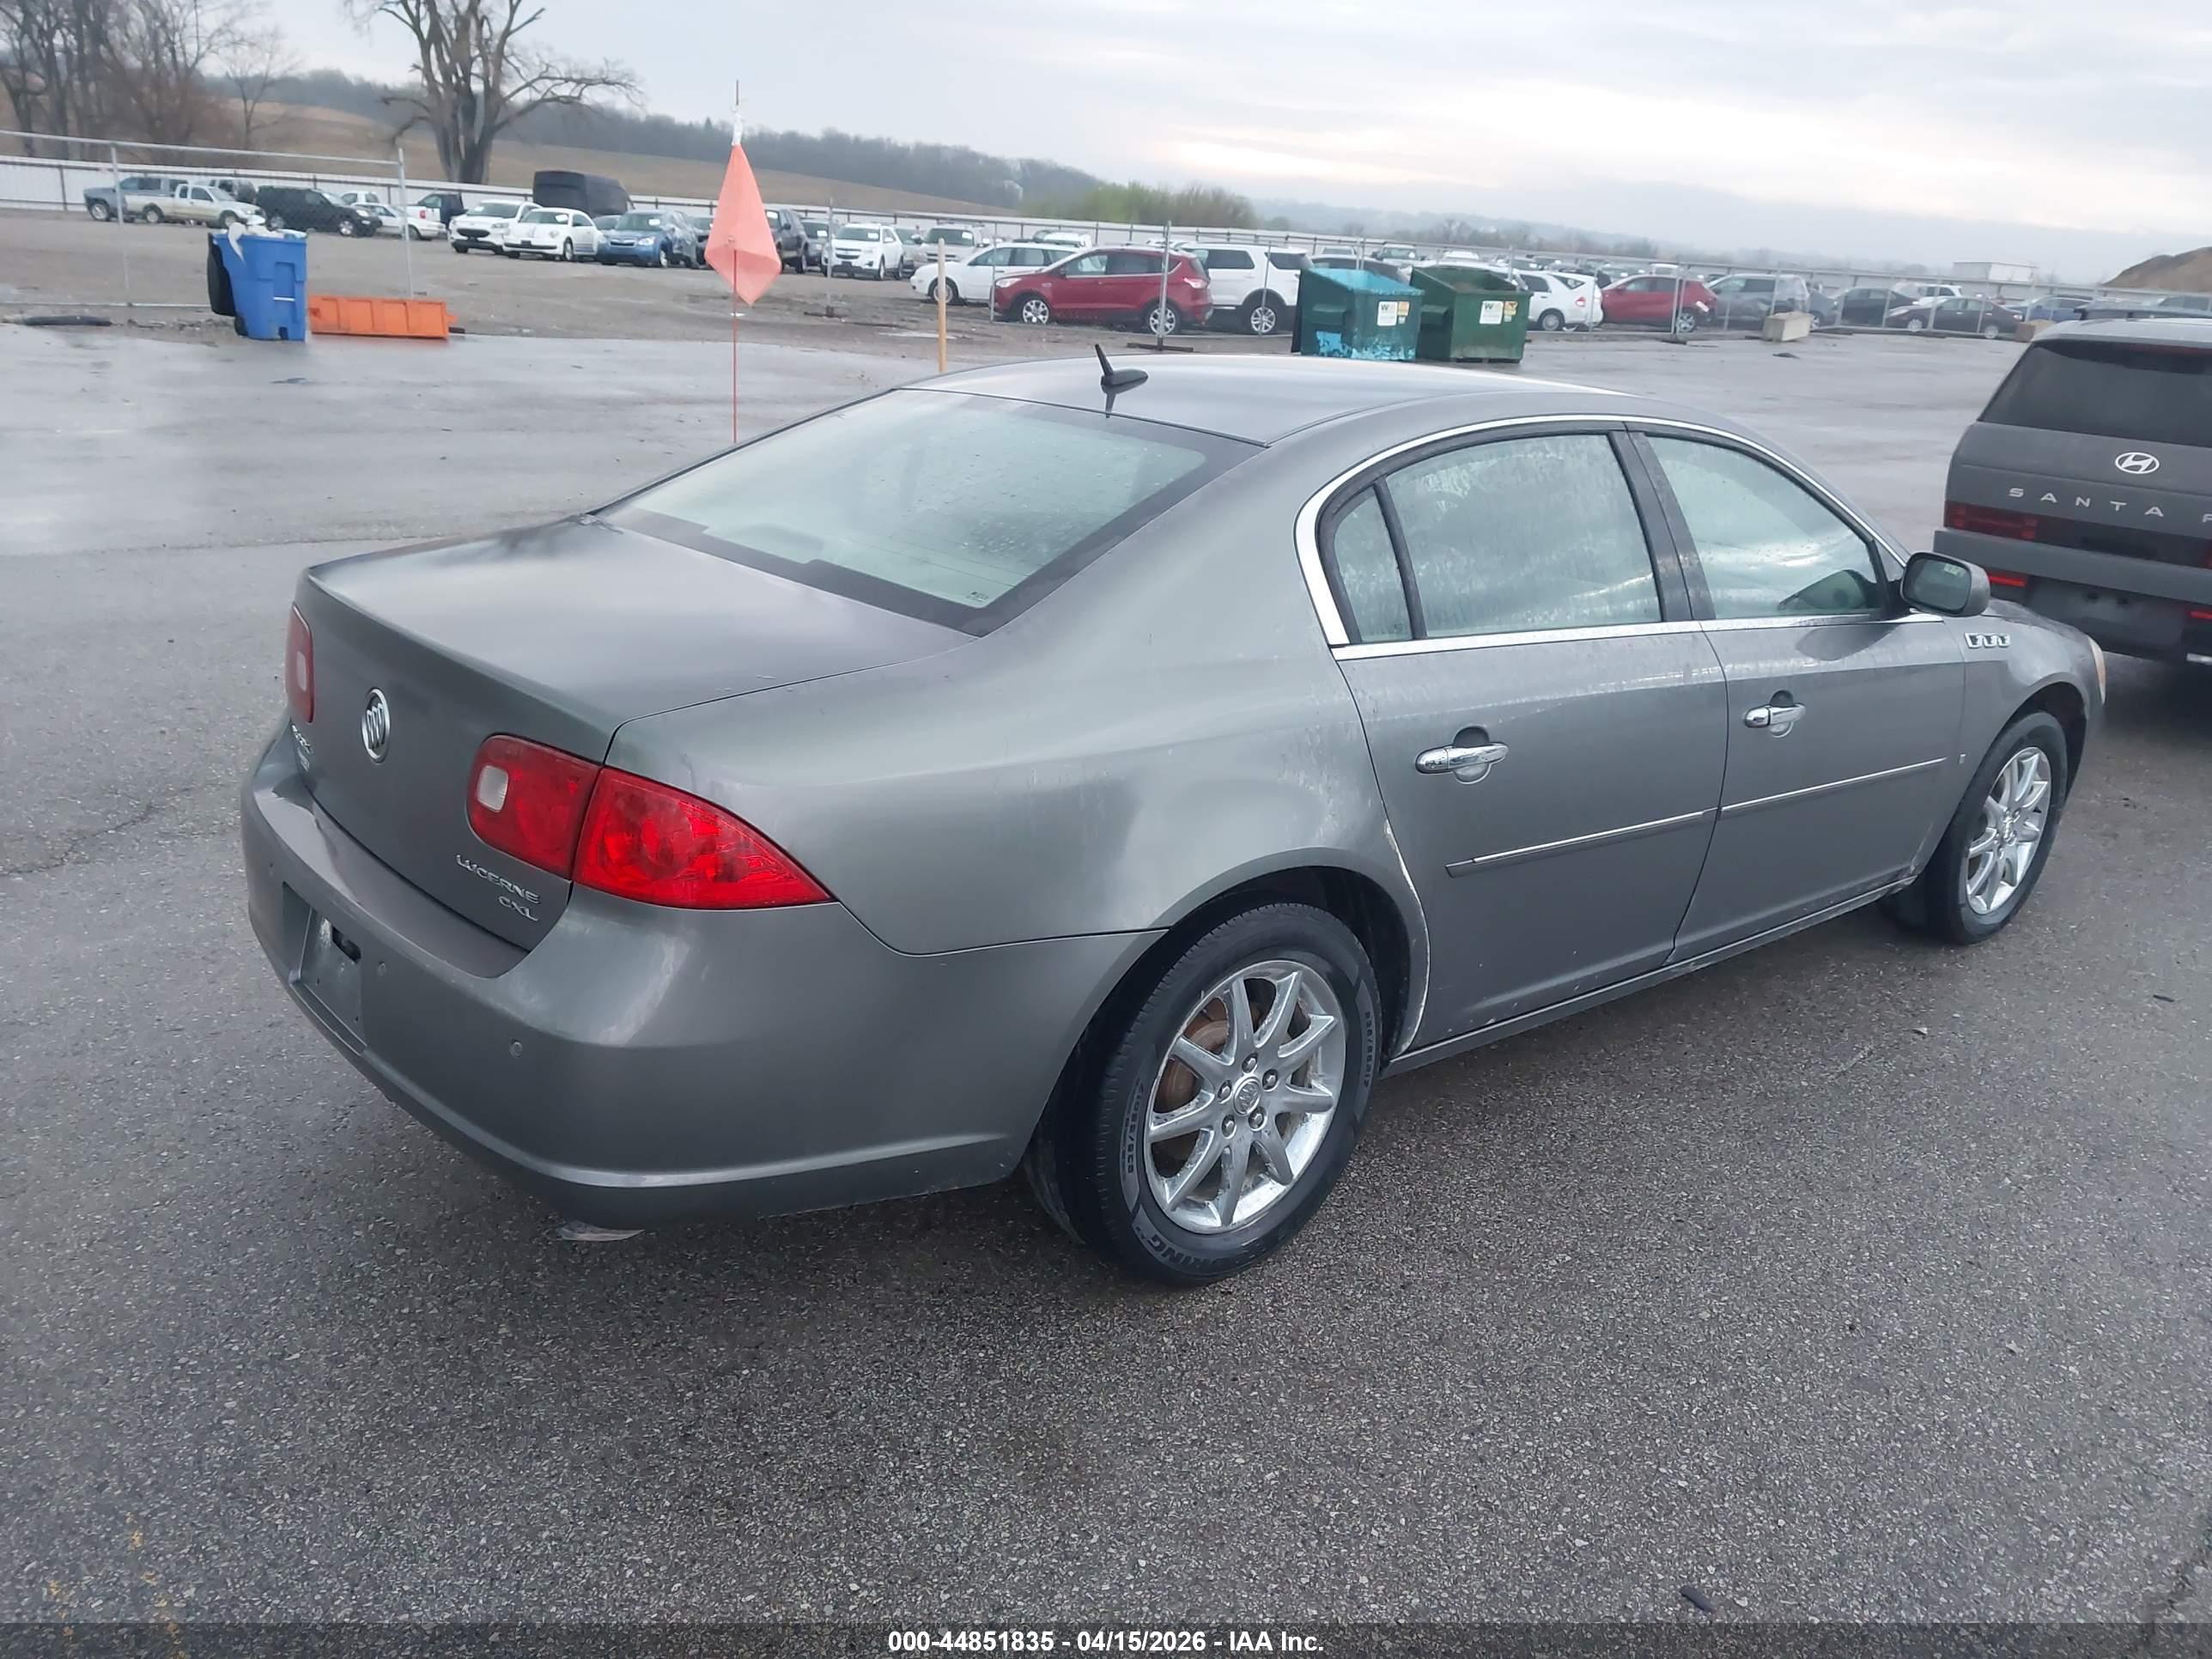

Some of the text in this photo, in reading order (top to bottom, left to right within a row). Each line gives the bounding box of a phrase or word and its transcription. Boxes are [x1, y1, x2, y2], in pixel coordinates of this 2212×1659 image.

[2008, 488, 2164, 517] SANTA
[456, 854, 539, 904] LUCERNE
[498, 896, 538, 921] CXL
